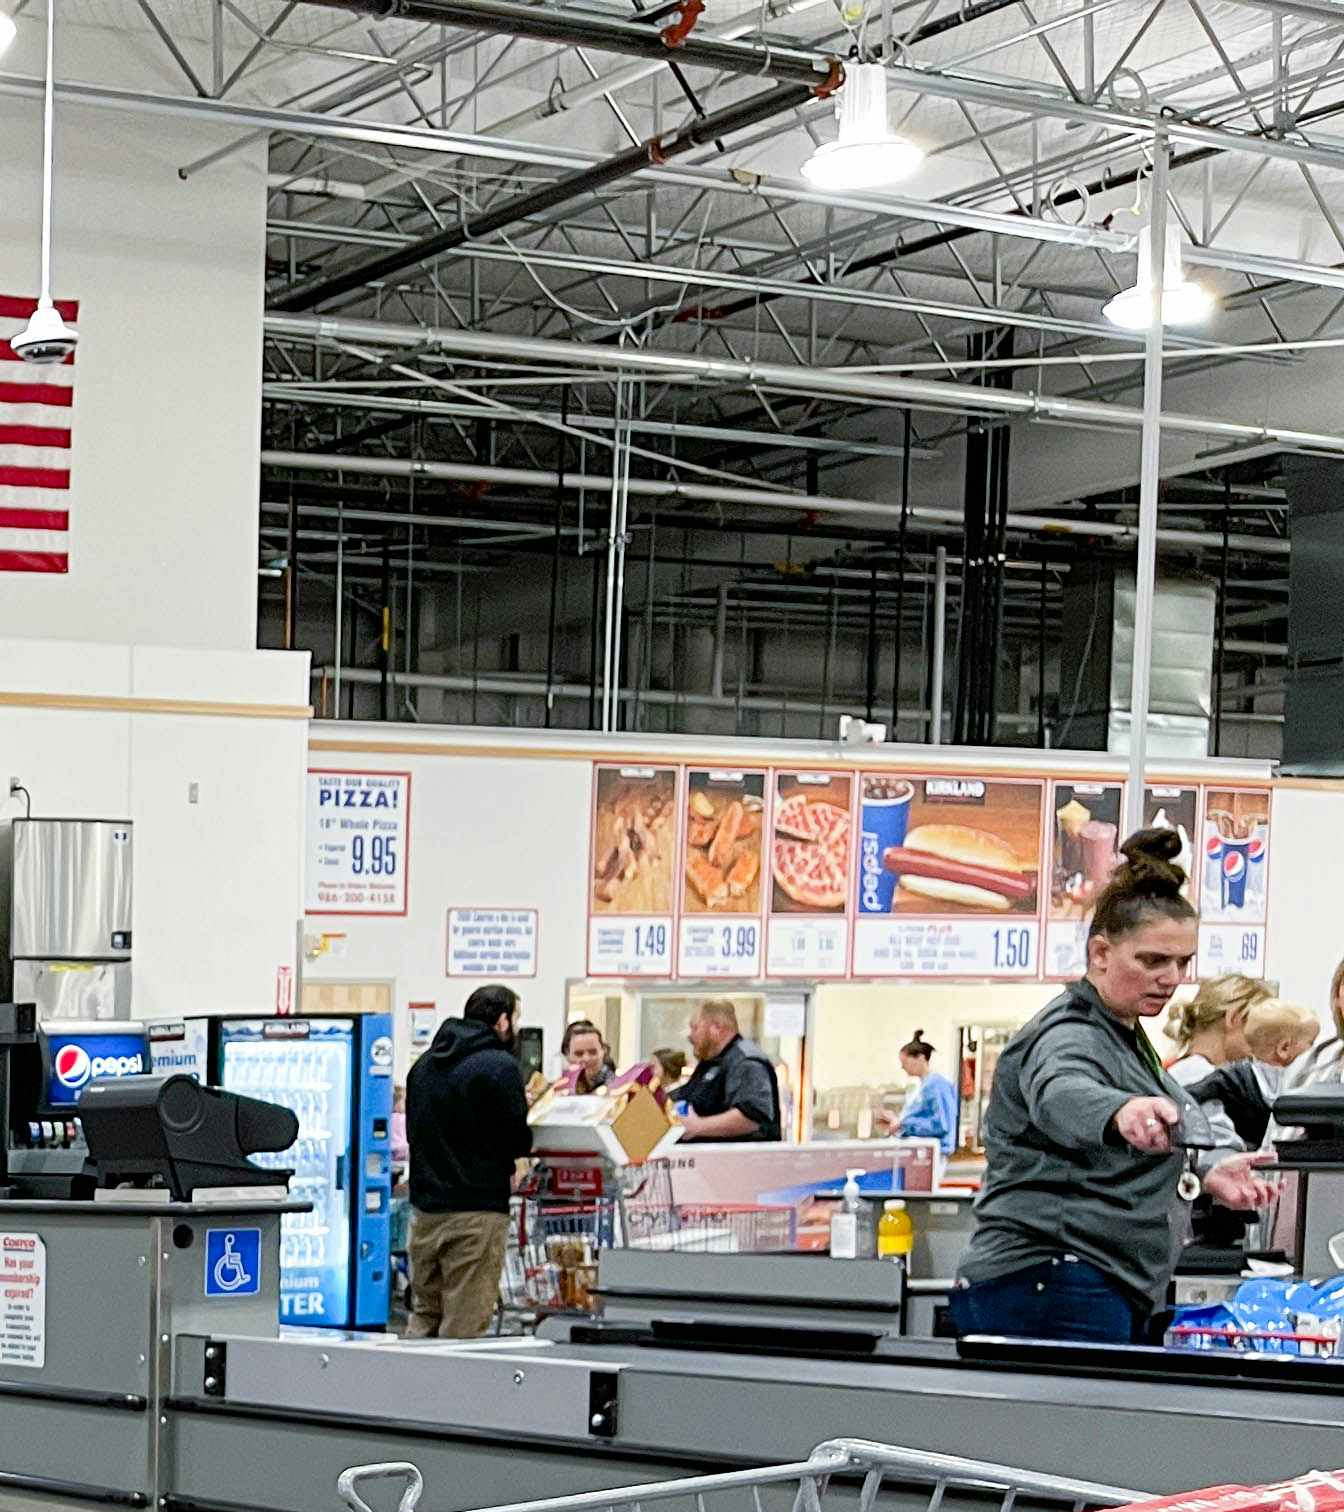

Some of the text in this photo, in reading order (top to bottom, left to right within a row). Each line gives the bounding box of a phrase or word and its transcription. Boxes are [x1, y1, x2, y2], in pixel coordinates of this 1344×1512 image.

[319, 789, 398, 808] PIZZA!
[352, 835, 396, 875] 9.95
[861, 831, 883, 911] pepsi
[635, 925, 666, 957] 1.49
[722, 926, 756, 957] 3.99
[993, 929, 1030, 968] 1.50
[91, 1053, 143, 1077] pepsi
[154, 1051, 196, 1066] mium
[281, 1293, 324, 1315] TER
